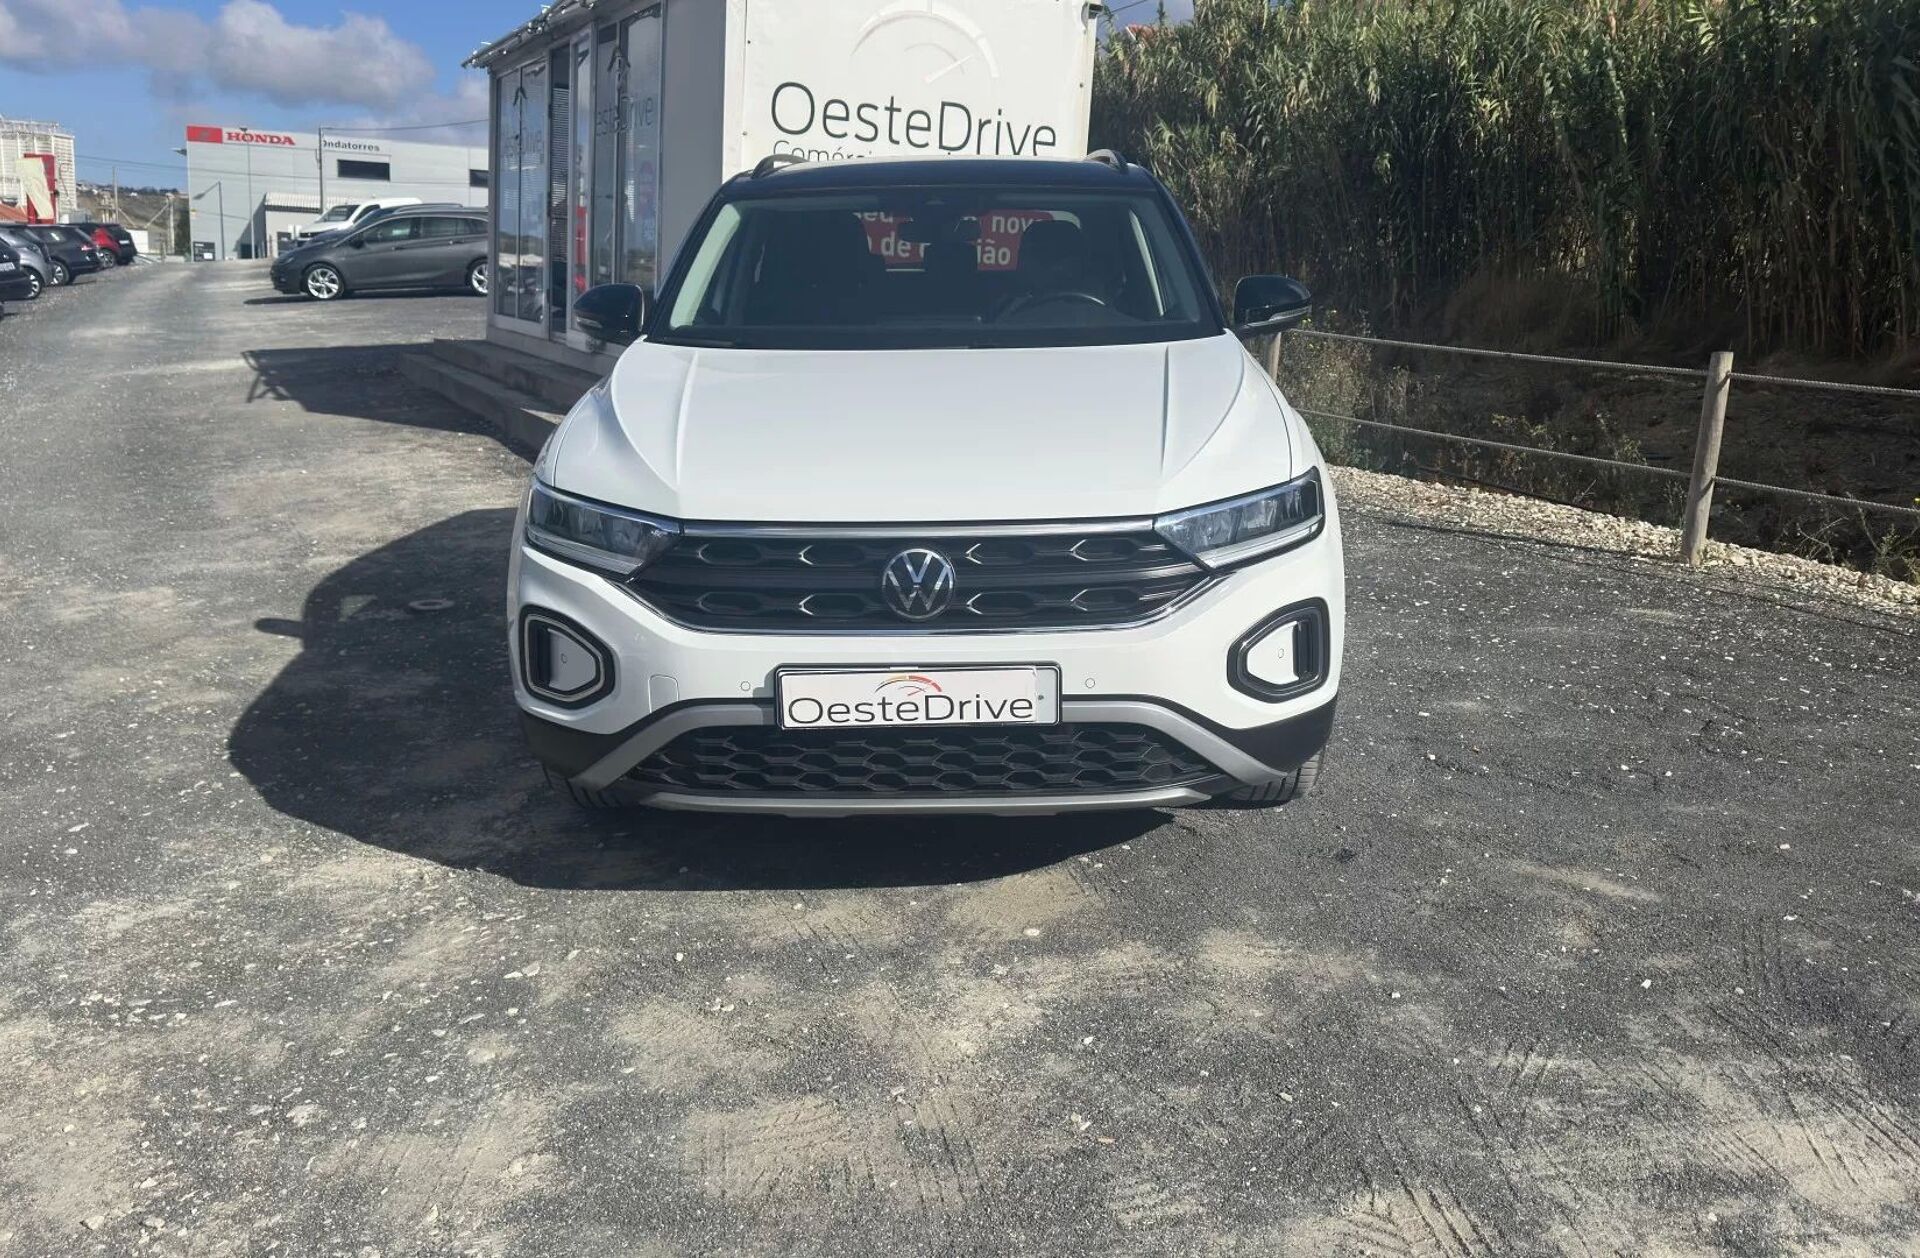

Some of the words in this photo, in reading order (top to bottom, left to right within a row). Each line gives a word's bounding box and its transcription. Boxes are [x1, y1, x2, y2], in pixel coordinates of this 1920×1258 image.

[771, 81, 1057, 156] OesteDrive
[226, 131, 296, 146] HONDA
[992, 215, 1035, 234] nov
[881, 231, 912, 257] de
[788, 694, 1033, 724] OesteDrive
